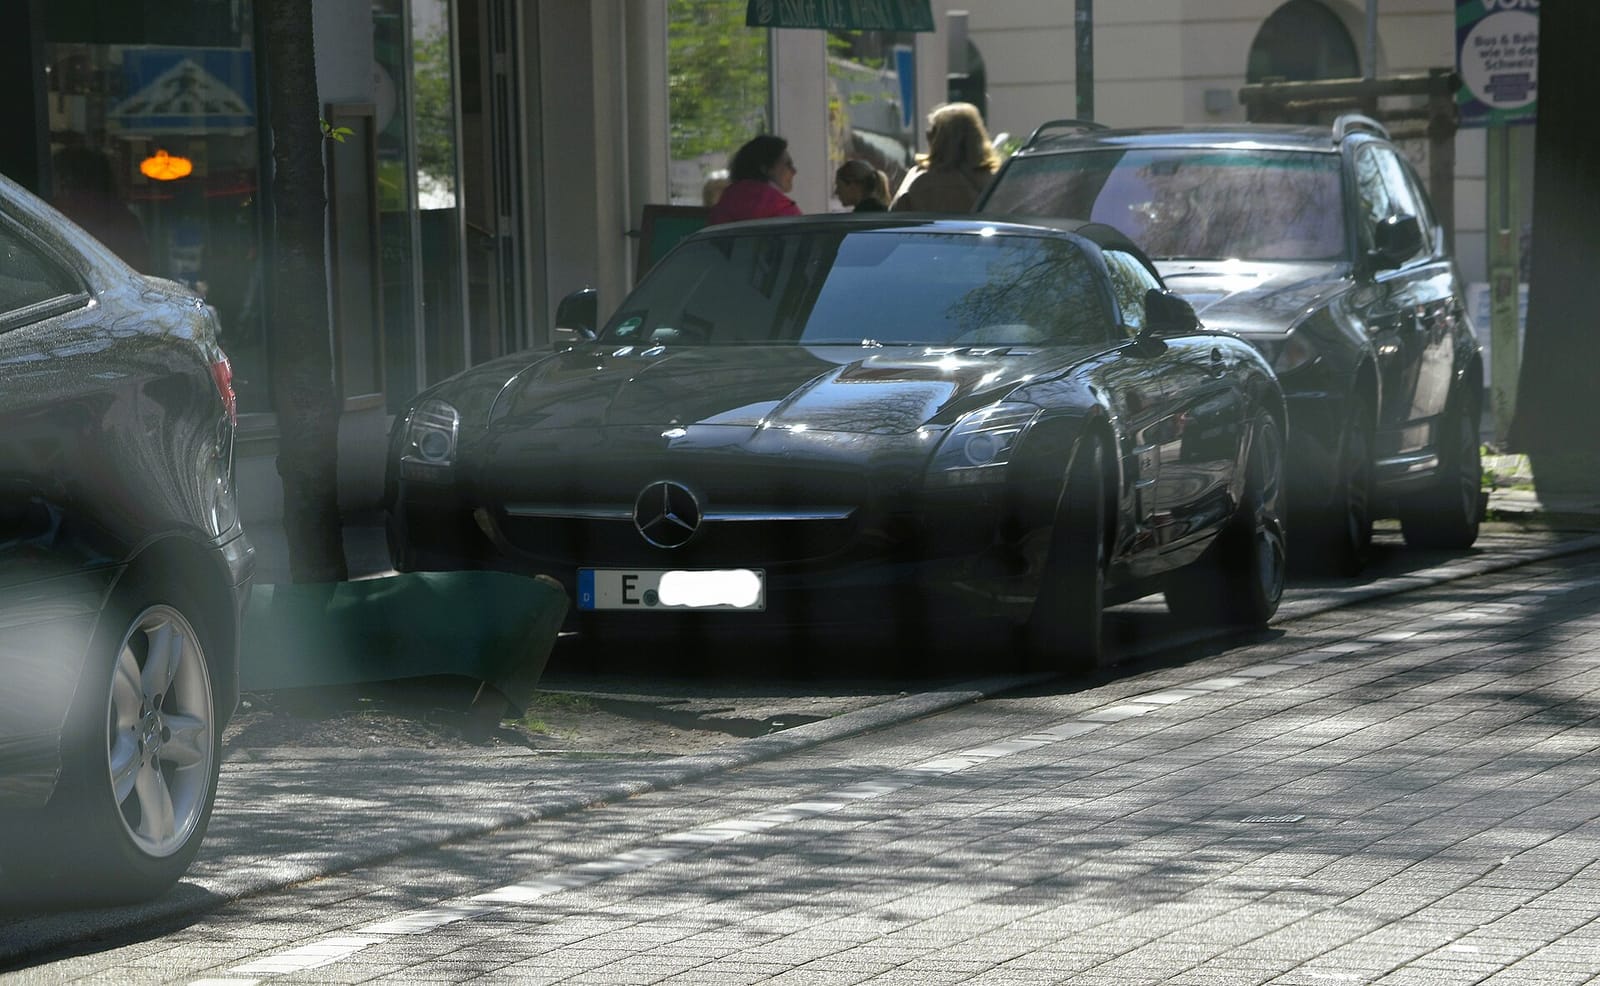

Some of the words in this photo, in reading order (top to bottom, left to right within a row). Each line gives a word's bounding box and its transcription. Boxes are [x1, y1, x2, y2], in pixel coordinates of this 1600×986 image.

[1474, 36, 1497, 46] Bus
[1513, 33, 1538, 44] Bah
[1480, 48, 1501, 58] wie
[1504, 47, 1516, 57] in
[1484, 59, 1534, 71] Schweiz
[622, 575, 640, 604] E
